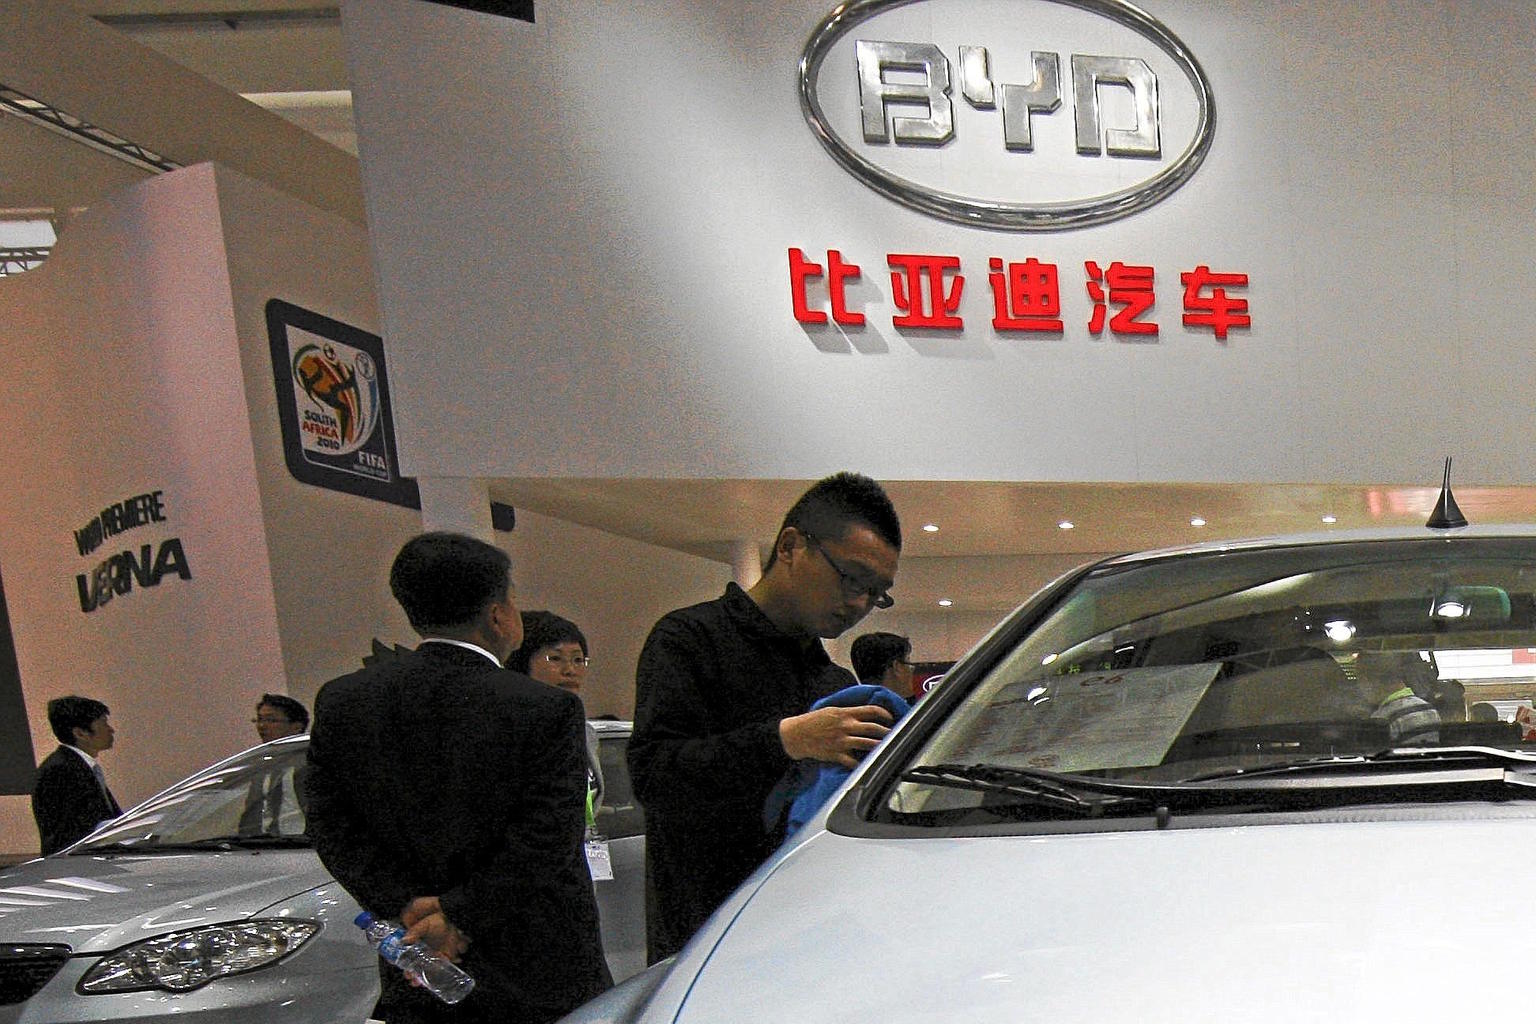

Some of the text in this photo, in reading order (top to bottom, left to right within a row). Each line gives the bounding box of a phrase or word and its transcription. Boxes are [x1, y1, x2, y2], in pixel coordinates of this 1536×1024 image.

[856, 39, 1162, 160] BYD
[788, 247, 1251, 339] 比亚迪汽车
[304, 409, 337, 427] SOUTH
[302, 421, 339, 440] AFRICA
[317, 436, 340, 450] 2010
[358, 451, 386, 469] FIFA
[75, 537, 193, 613] VERNA
